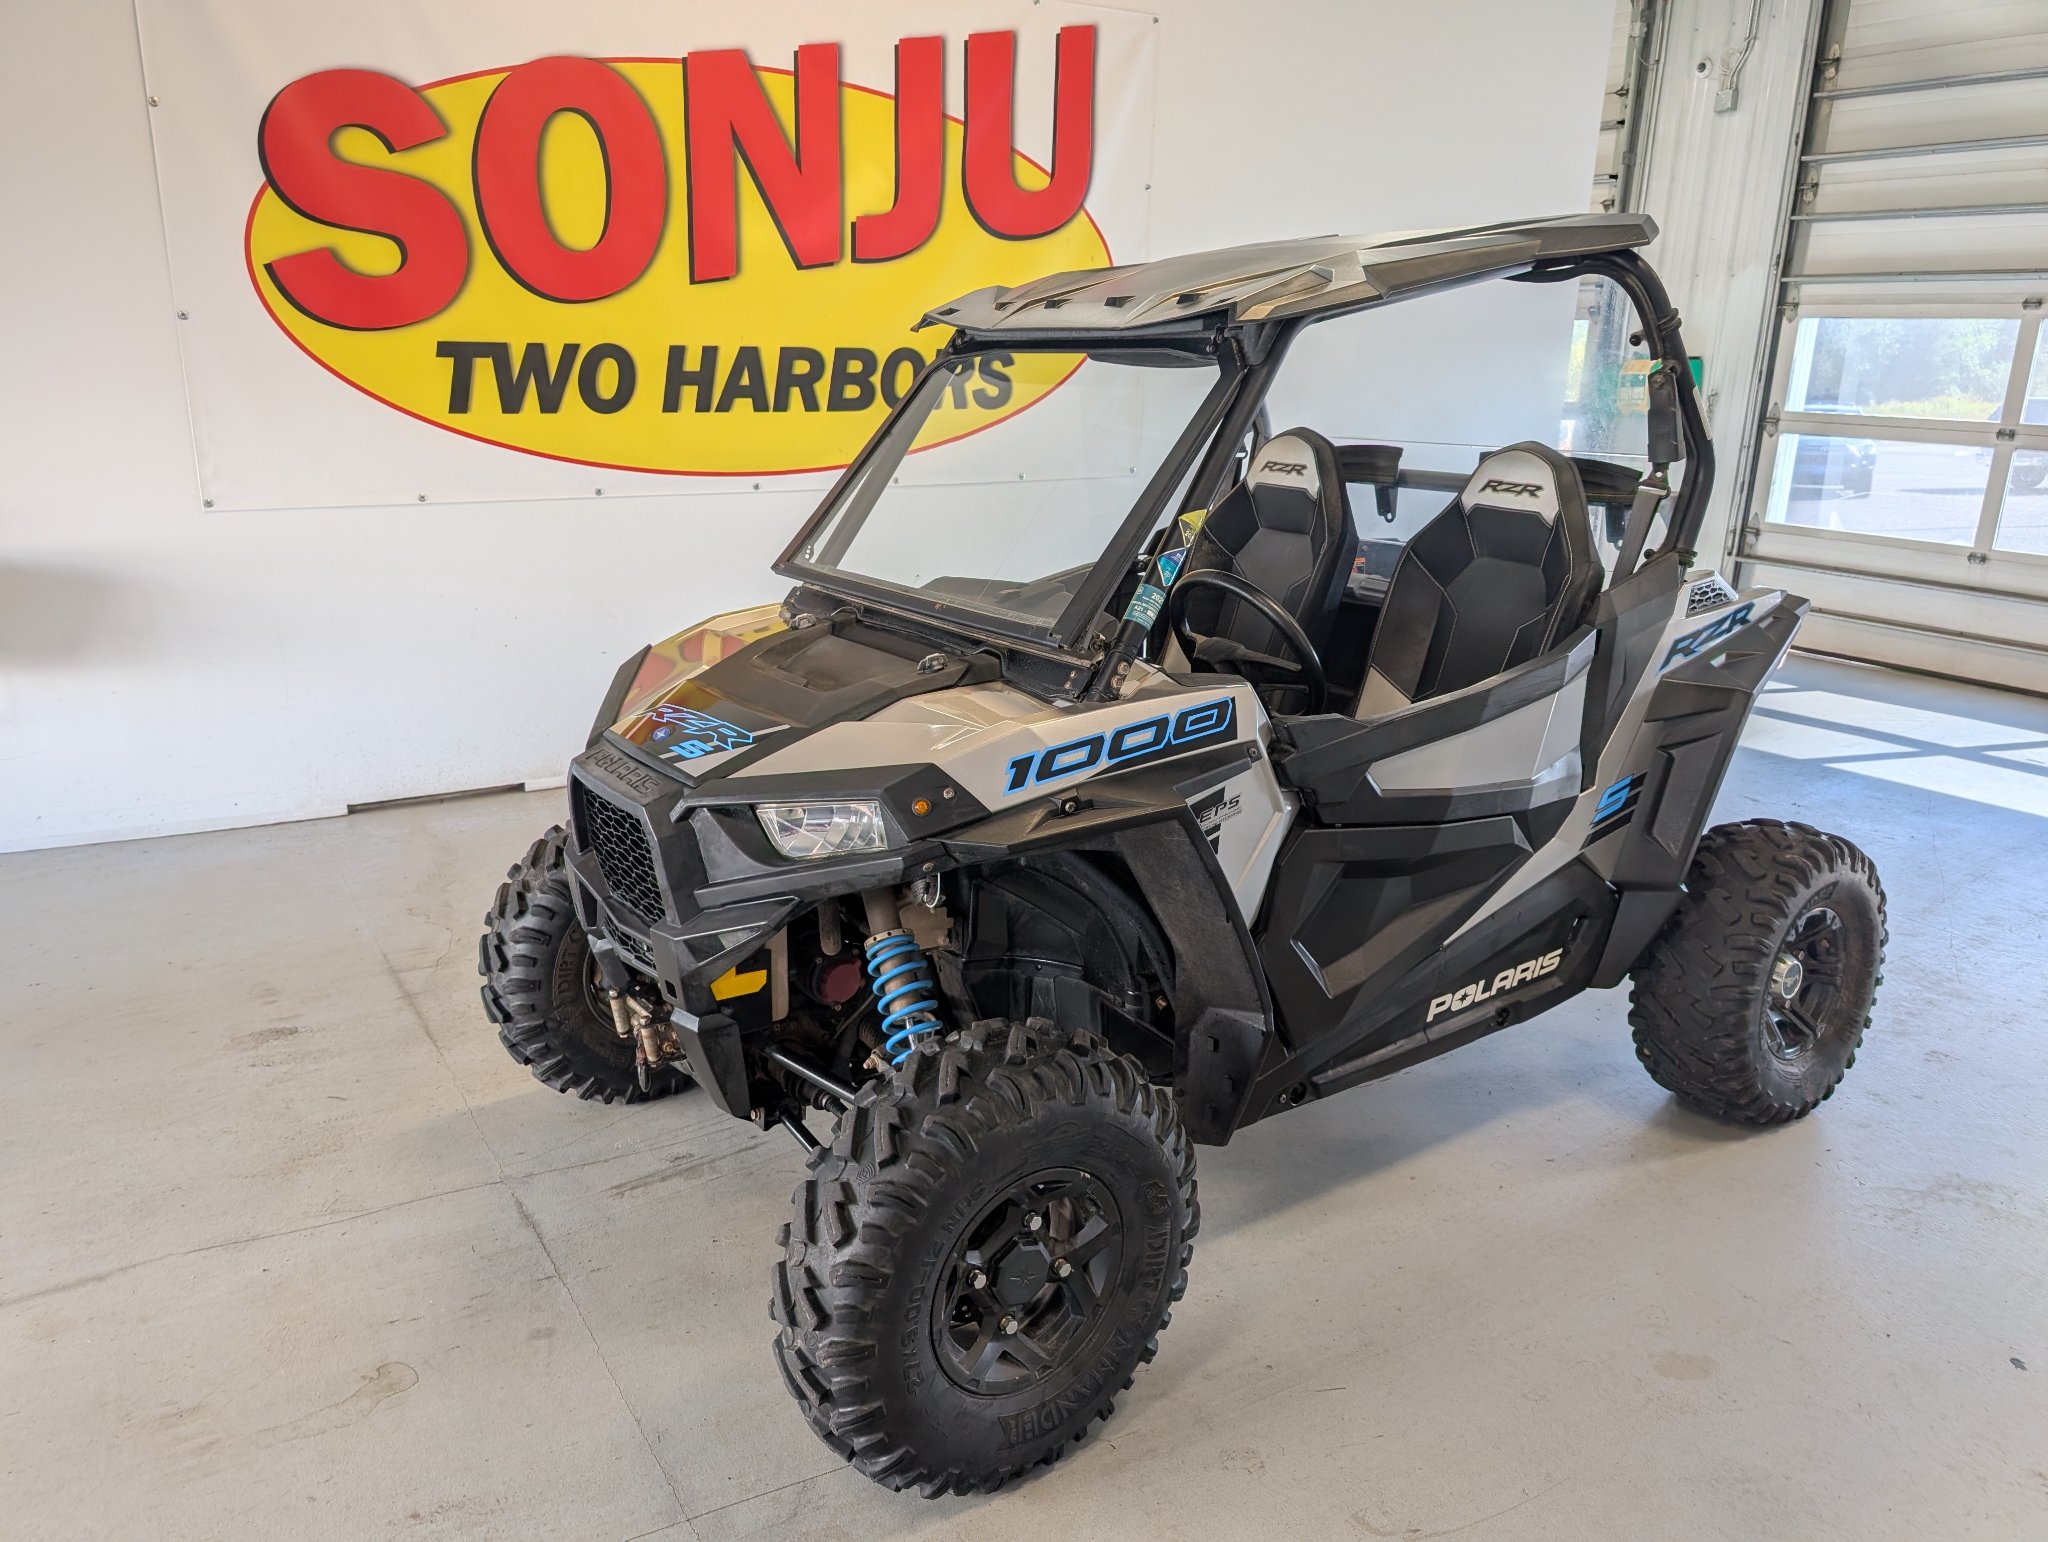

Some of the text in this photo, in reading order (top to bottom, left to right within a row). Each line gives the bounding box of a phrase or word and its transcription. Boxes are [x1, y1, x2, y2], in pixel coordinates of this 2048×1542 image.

[258, 25, 1095, 331] SONJU
[436, 341, 1015, 414] TWO HARBORS
[1259, 460, 1309, 477] RZR
[1477, 478, 1545, 499] RZR
[1654, 601, 1755, 676] RZR
[632, 703, 753, 751] RZR
[1003, 696, 1234, 796] 1000
[585, 748, 665, 795] POLARIS
[1199, 793, 1242, 823] EPS
[1426, 948, 1563, 1023] POLARIS
